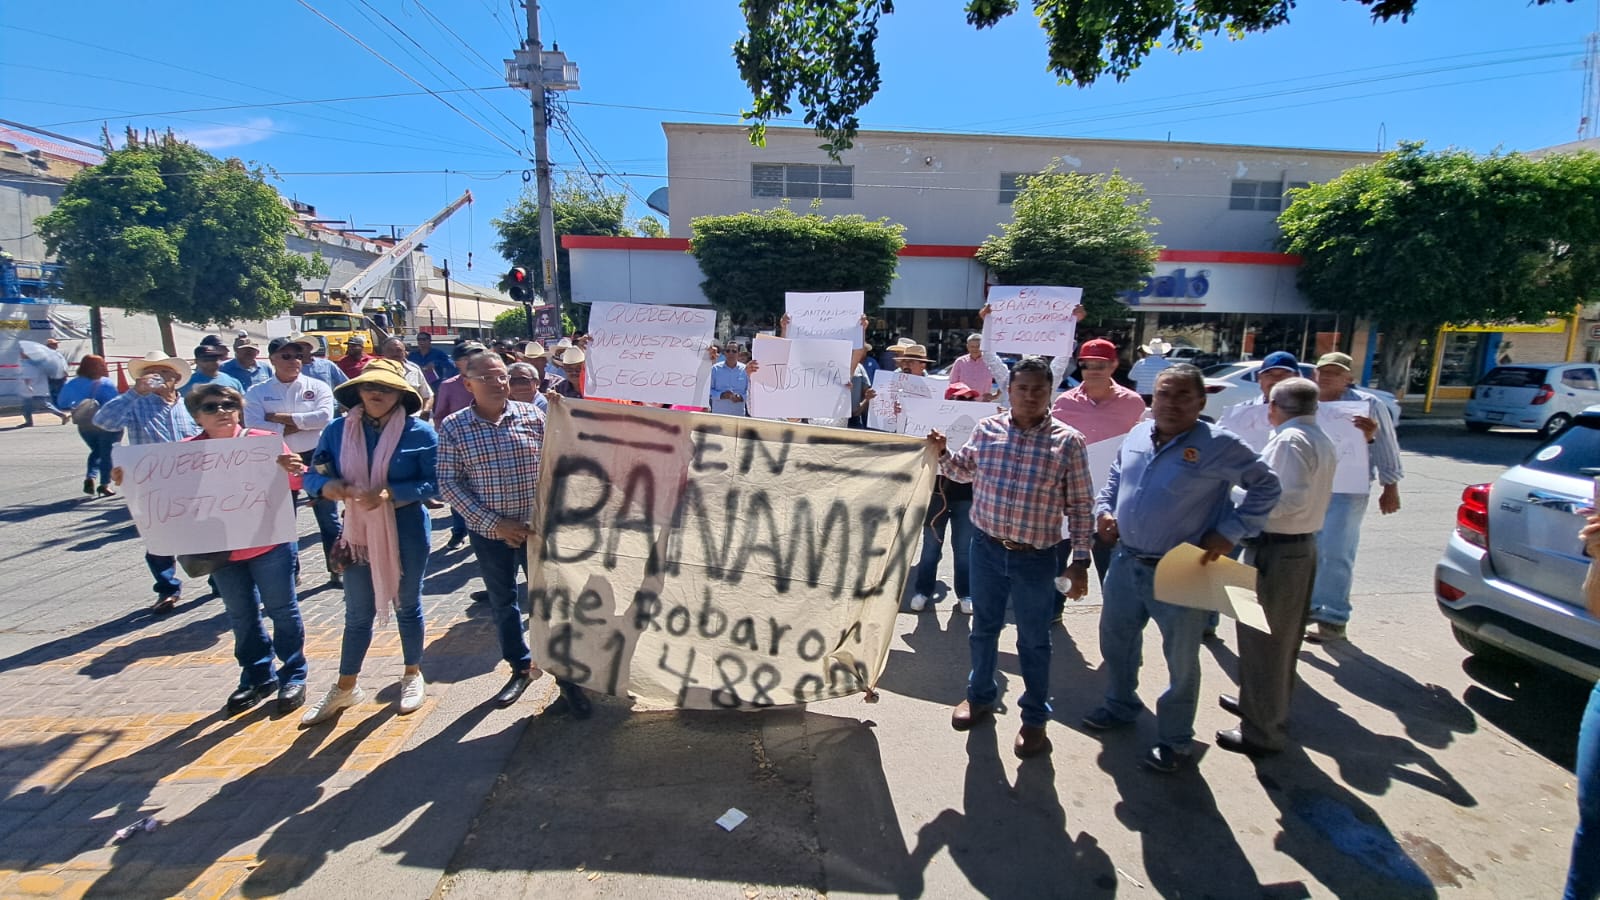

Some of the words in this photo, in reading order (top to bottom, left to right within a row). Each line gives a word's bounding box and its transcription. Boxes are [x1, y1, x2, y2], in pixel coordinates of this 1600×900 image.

[594, 365, 698, 387] SEGURO
[761, 360, 843, 393] JUSTICIA
[691, 424, 795, 477] EN
[142, 481, 273, 530] JUSTICIA
[539, 453, 926, 604] BANAMEX
